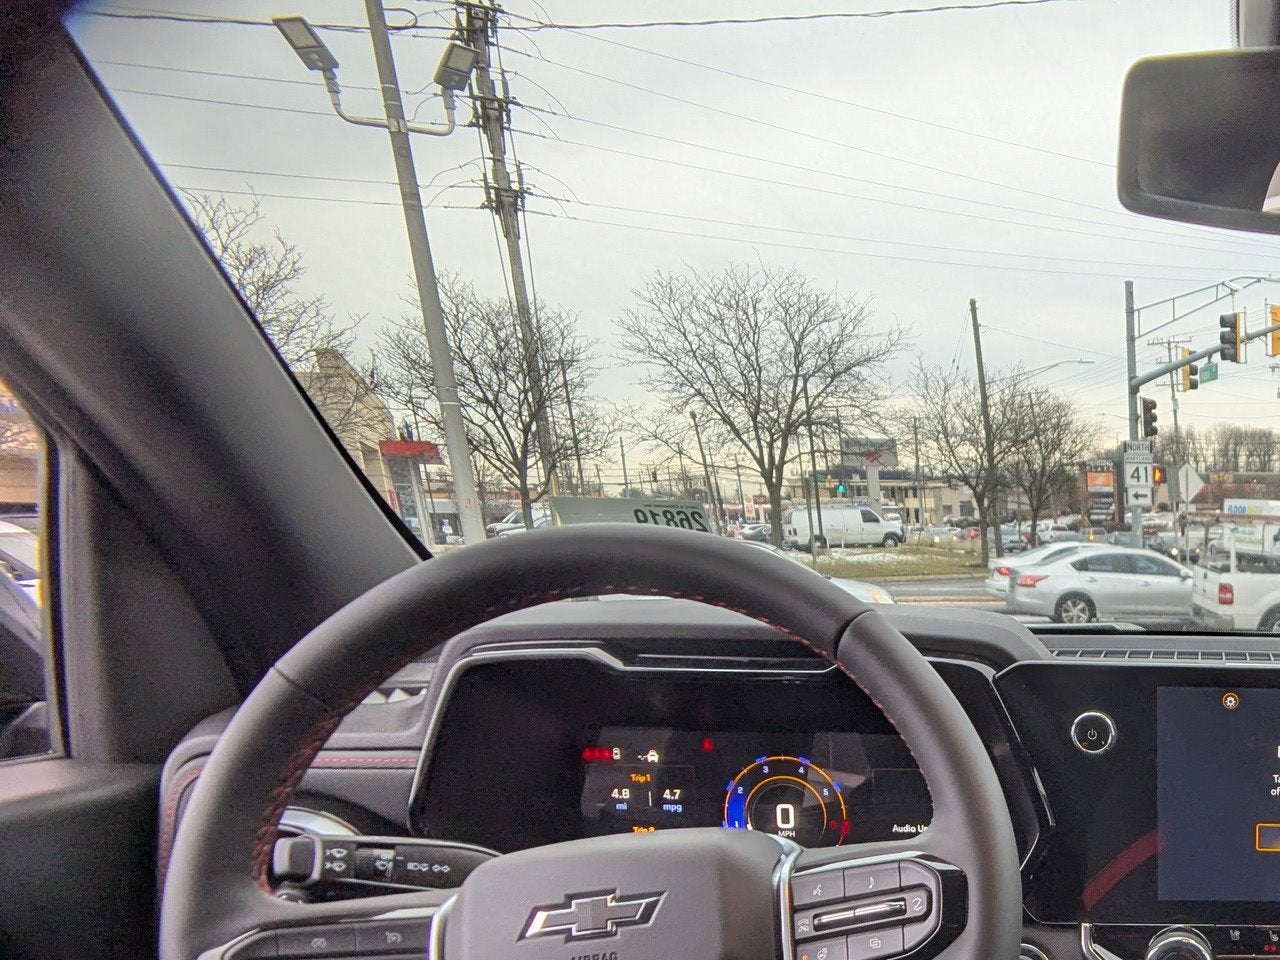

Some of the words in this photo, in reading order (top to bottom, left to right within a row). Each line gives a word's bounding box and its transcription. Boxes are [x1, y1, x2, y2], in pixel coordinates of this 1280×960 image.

[1127, 441, 1150, 452] NORTH
[1130, 465, 1148, 483] 41
[798, 766, 804, 774] 4
[630, 773, 646, 783] Trip
[611, 788, 630, 799] 4.8
[663, 789, 681, 800] 4.7
[616, 802, 628, 810] mi
[662, 803, 682, 813] mpg
[776, 803, 795, 829] 0
[829, 821, 837, 829] 6
[892, 824, 917, 833] Audio
[778, 830, 796, 838] MPH
